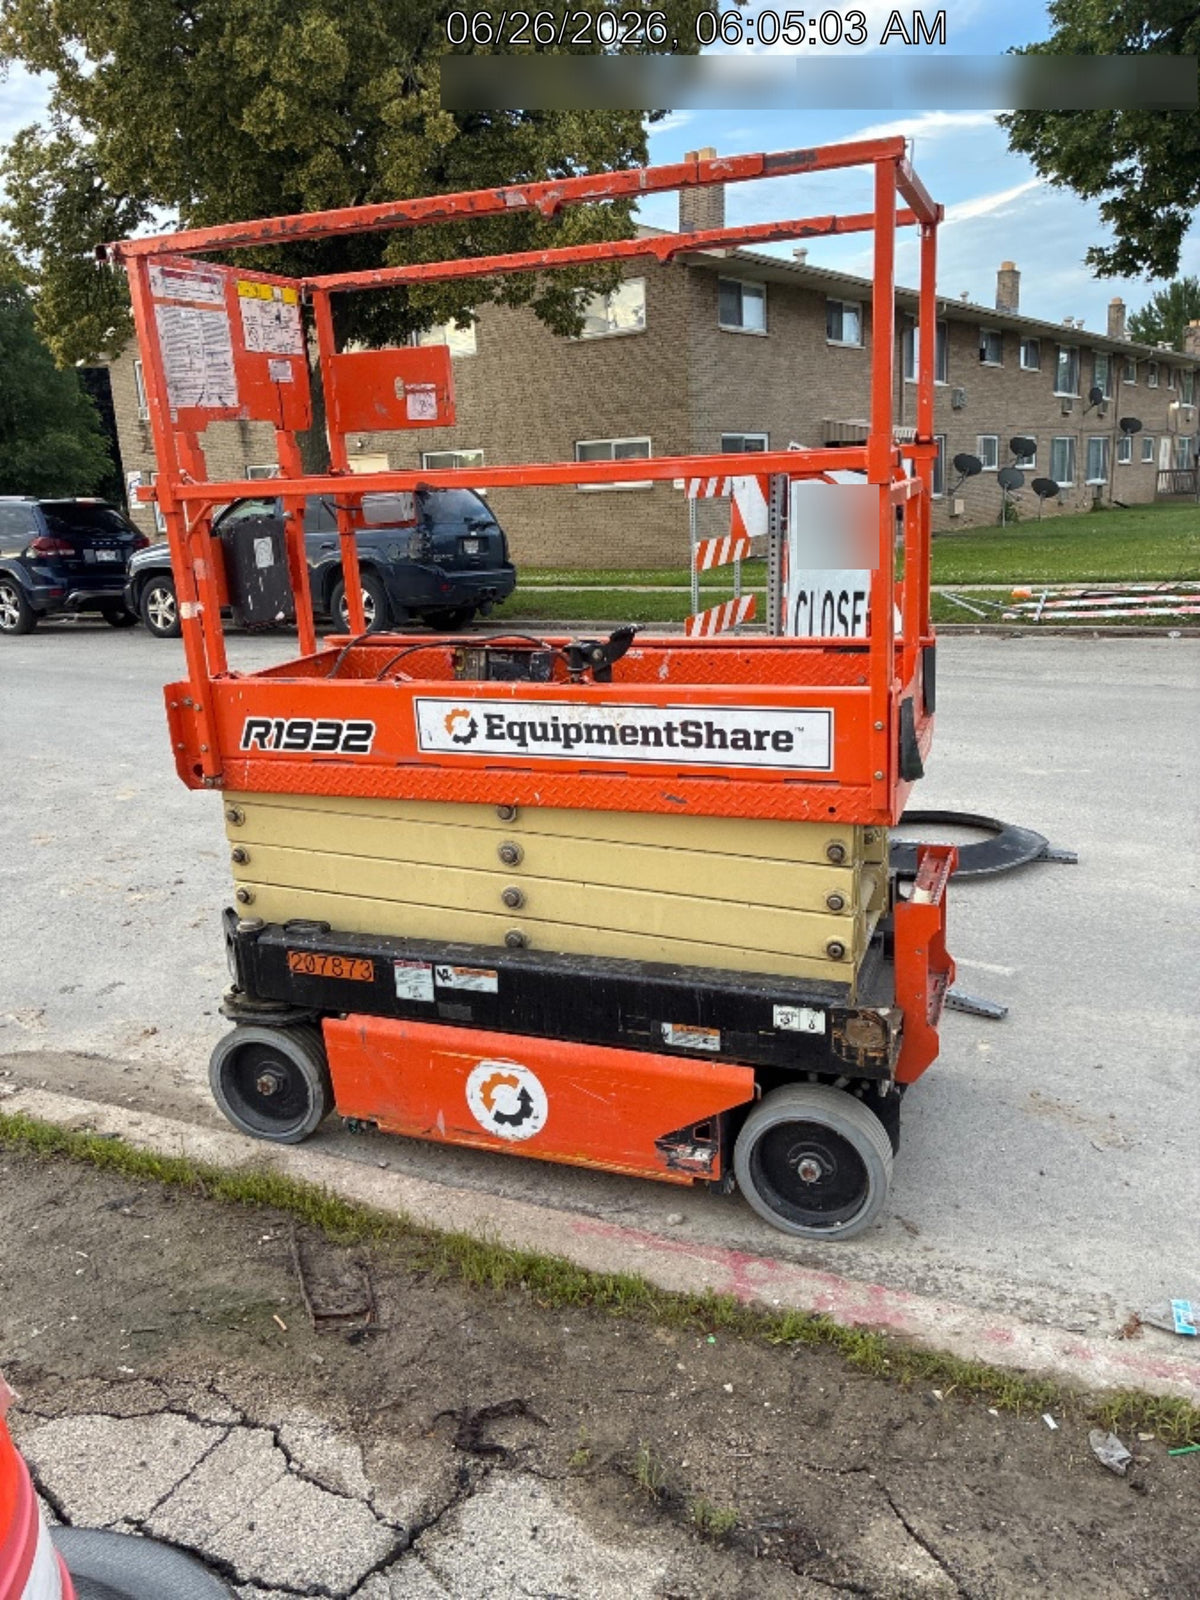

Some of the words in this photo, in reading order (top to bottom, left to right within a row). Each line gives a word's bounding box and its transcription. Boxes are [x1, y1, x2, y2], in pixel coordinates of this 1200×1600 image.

[241, 717, 375, 755] R1932
[484, 713, 795, 753] EquipmentShare
[290, 952, 373, 980] 207873
